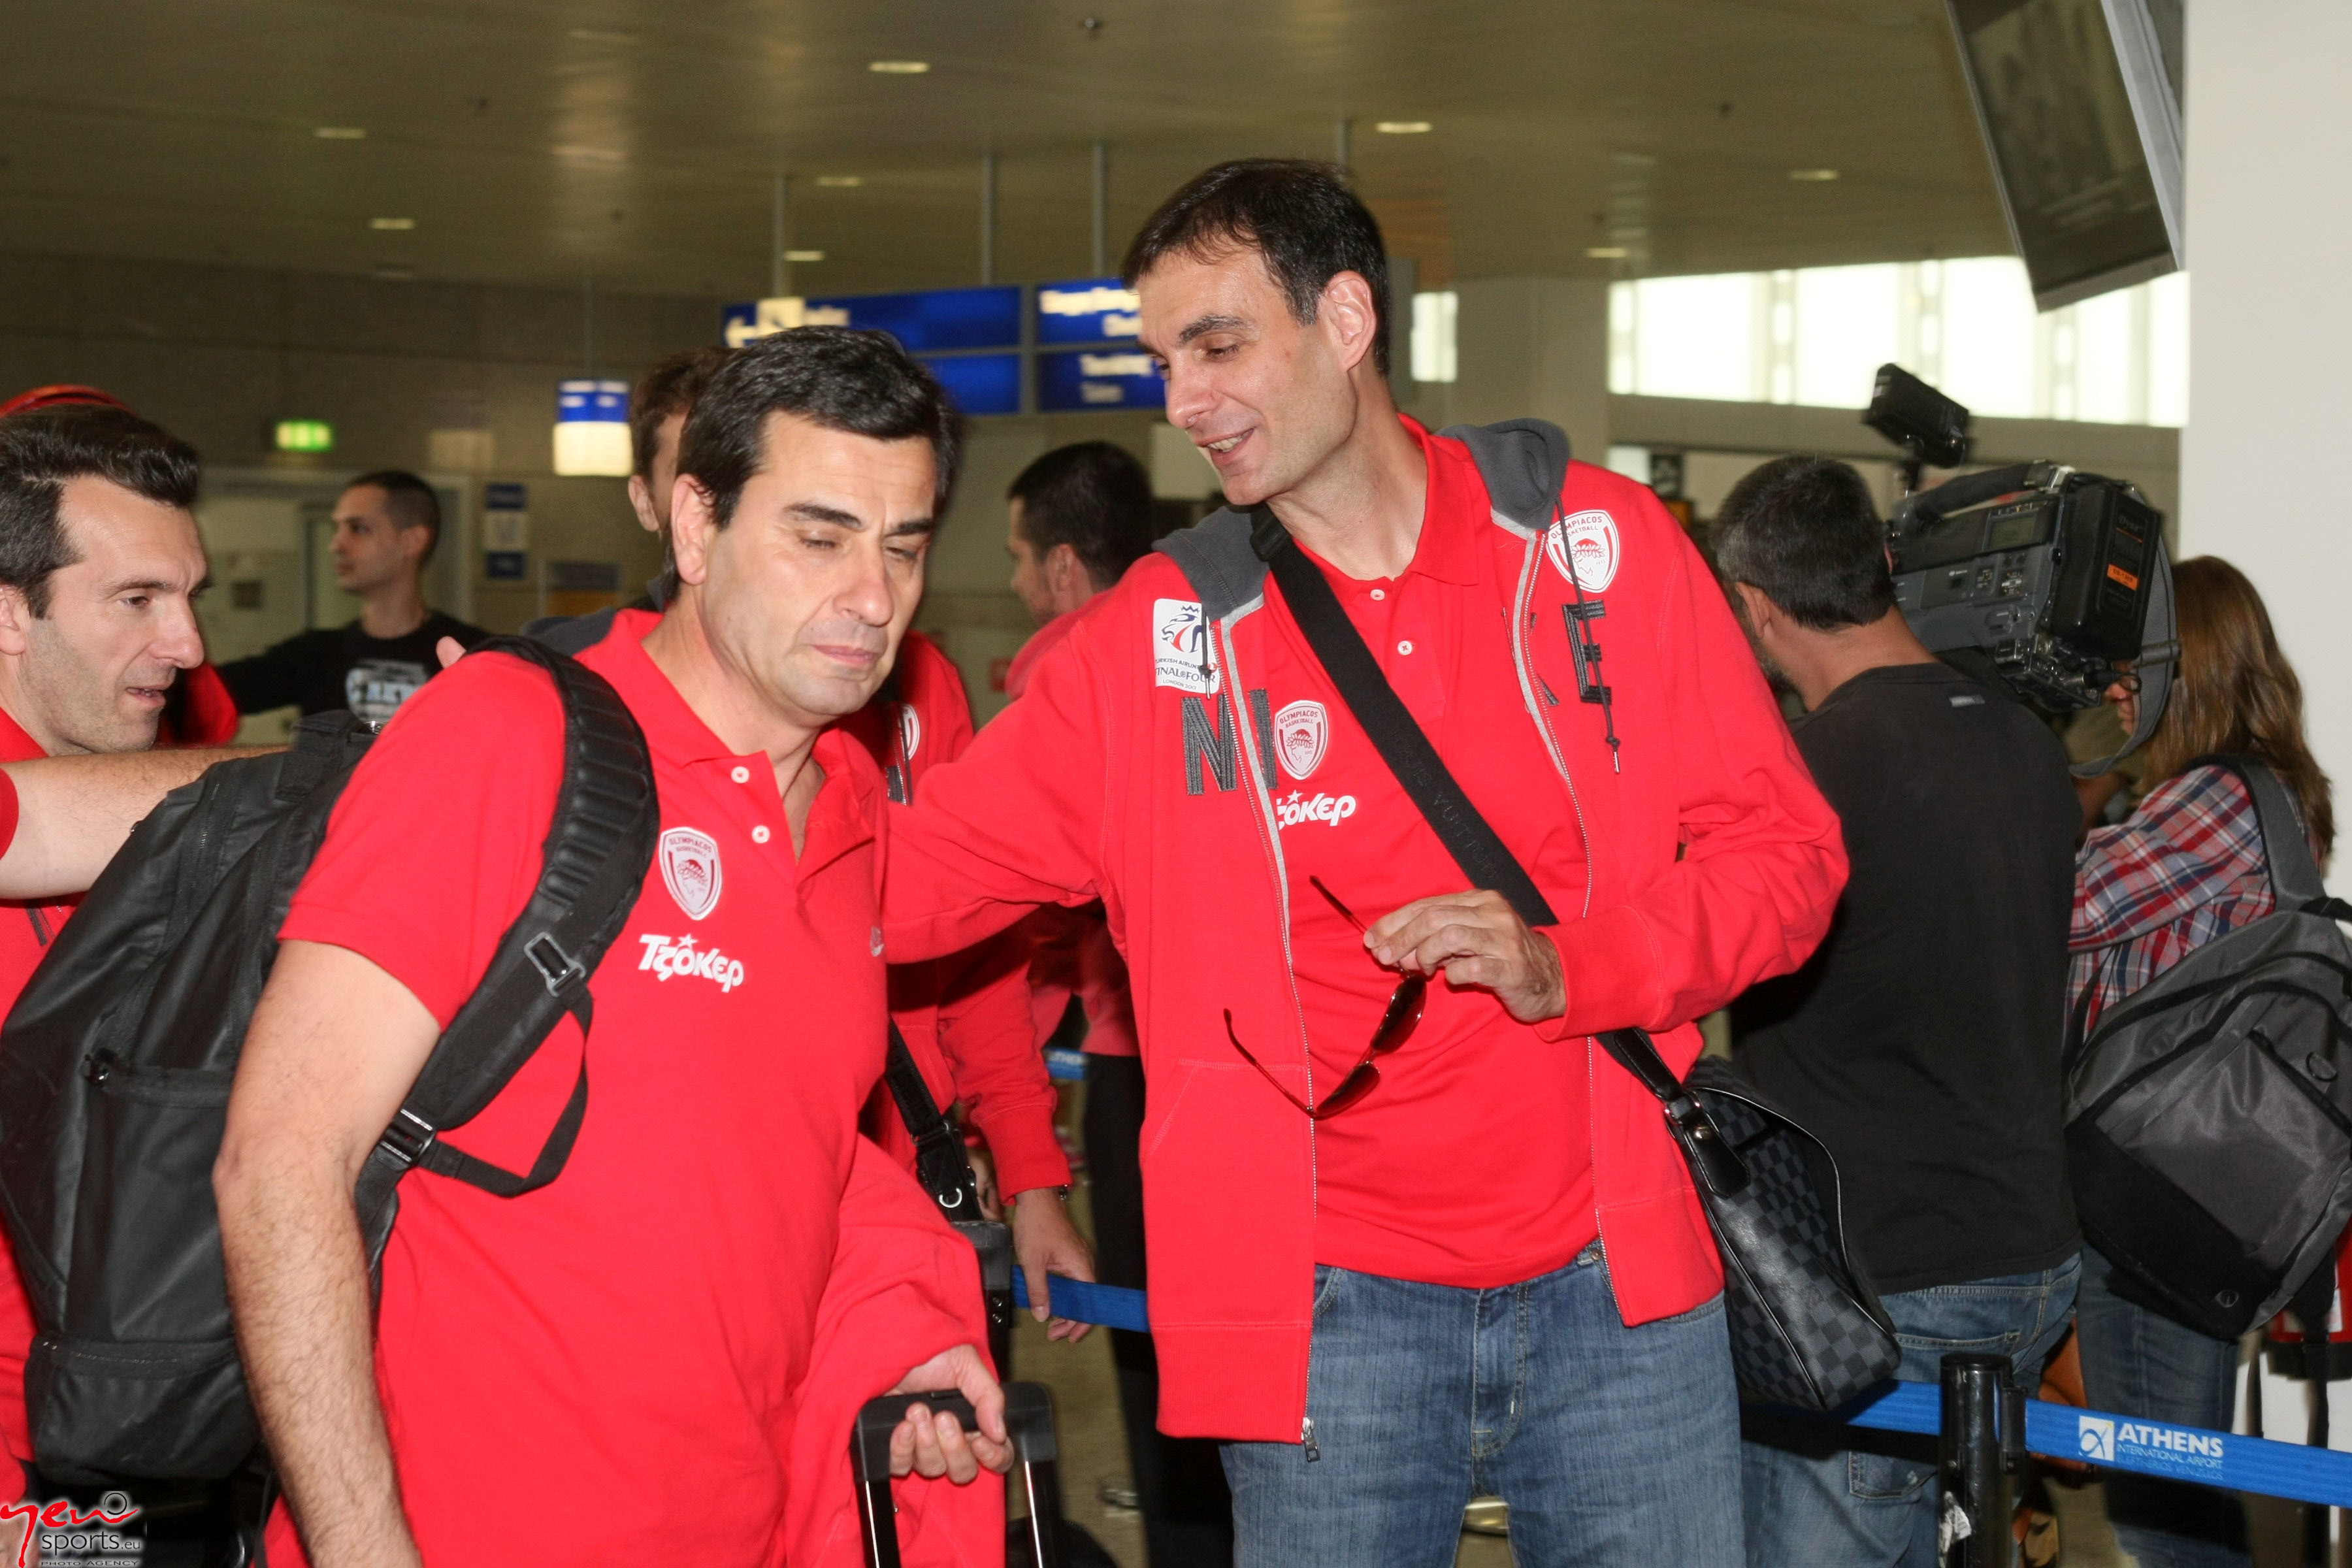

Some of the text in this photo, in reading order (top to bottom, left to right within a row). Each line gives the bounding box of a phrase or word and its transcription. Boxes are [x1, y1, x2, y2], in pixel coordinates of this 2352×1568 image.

[1550, 516, 1603, 539] OLMPIACOS
[1561, 525, 1599, 541] SKETBALL
[1154, 666, 1181, 678] INAL
[1163, 679, 1184, 687] LONDON
[1279, 710, 1318, 725] OLYMPIACOS
[1285, 718, 1314, 728] BASKETBALL
[669, 836, 712, 853] OLYMPIACOS
[2117, 1423, 2224, 1458] ATHENS
[2116, 1444, 2223, 1469] INTERNATIONAL AIRPORT
